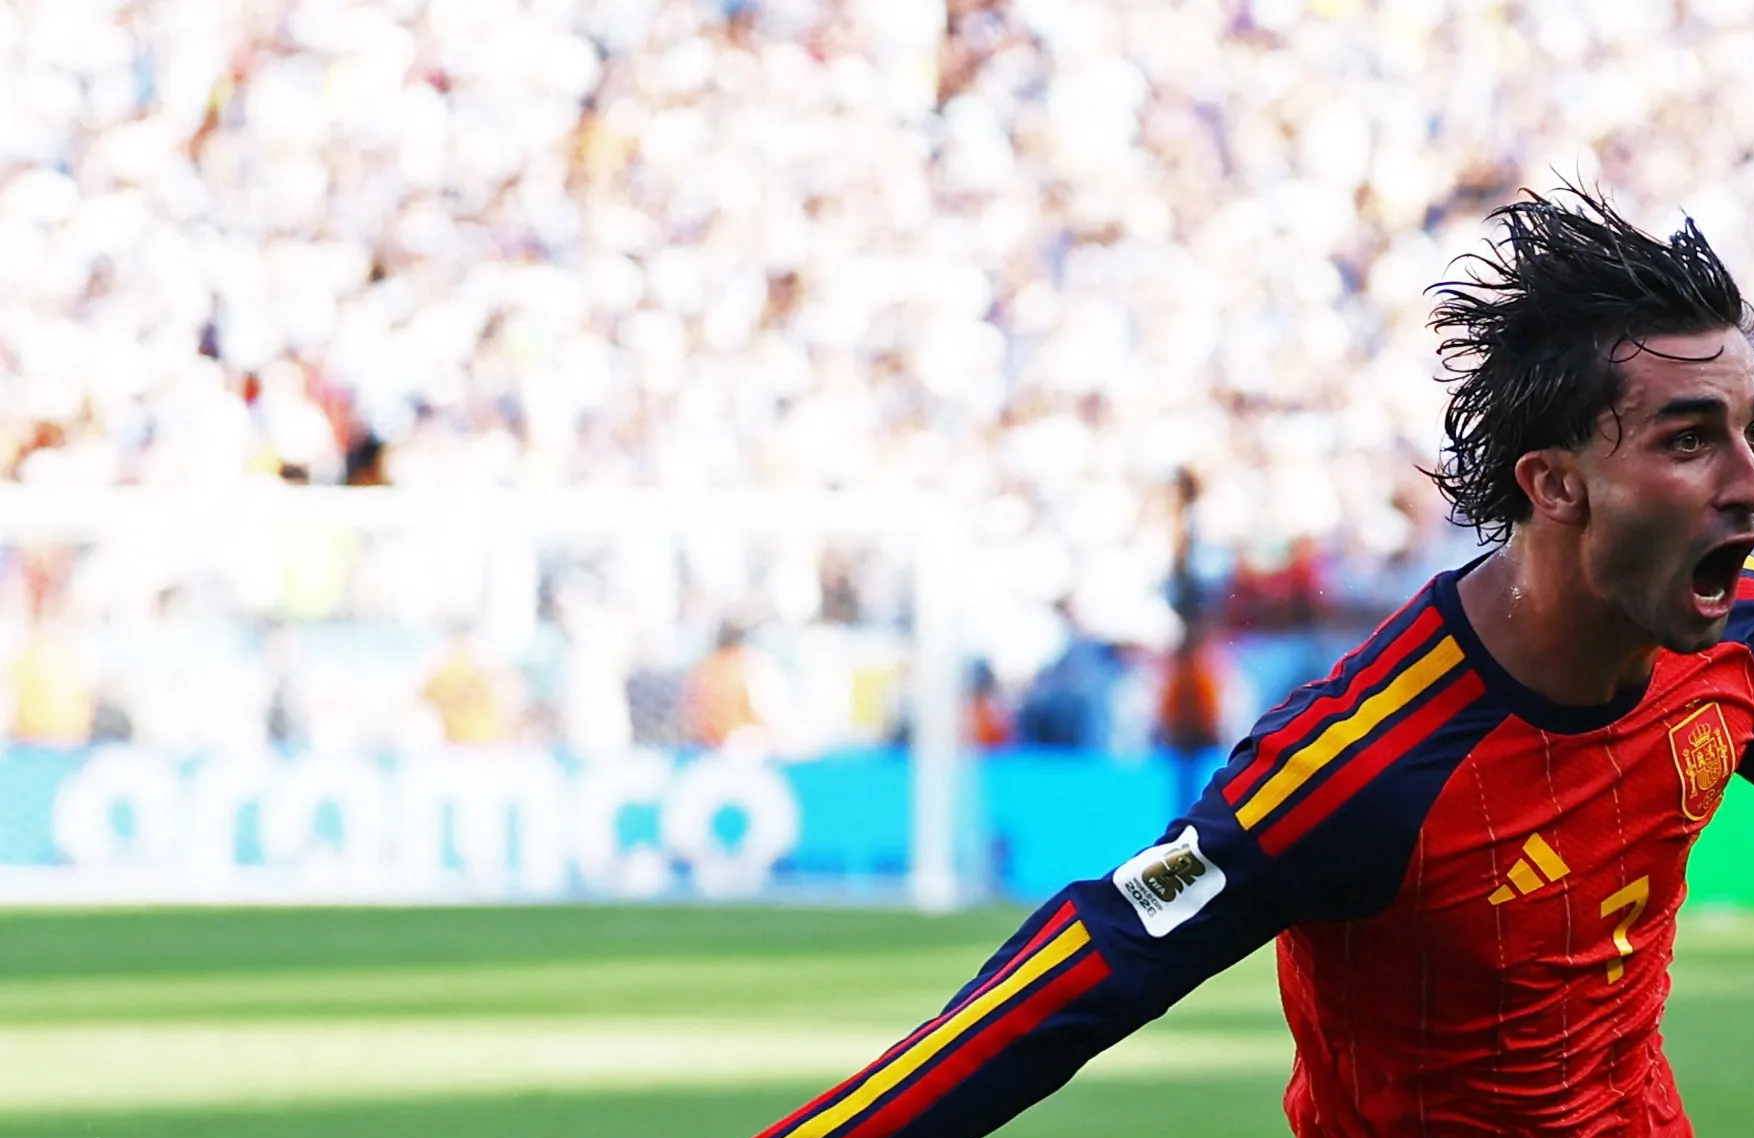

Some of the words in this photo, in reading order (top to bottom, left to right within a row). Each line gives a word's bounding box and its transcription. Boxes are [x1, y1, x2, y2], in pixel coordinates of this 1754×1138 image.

[53, 747, 798, 890] aramco
[1125, 881, 1157, 918] 2026
[1148, 877, 1166, 895] FIFA
[1600, 875, 1650, 985] 7
